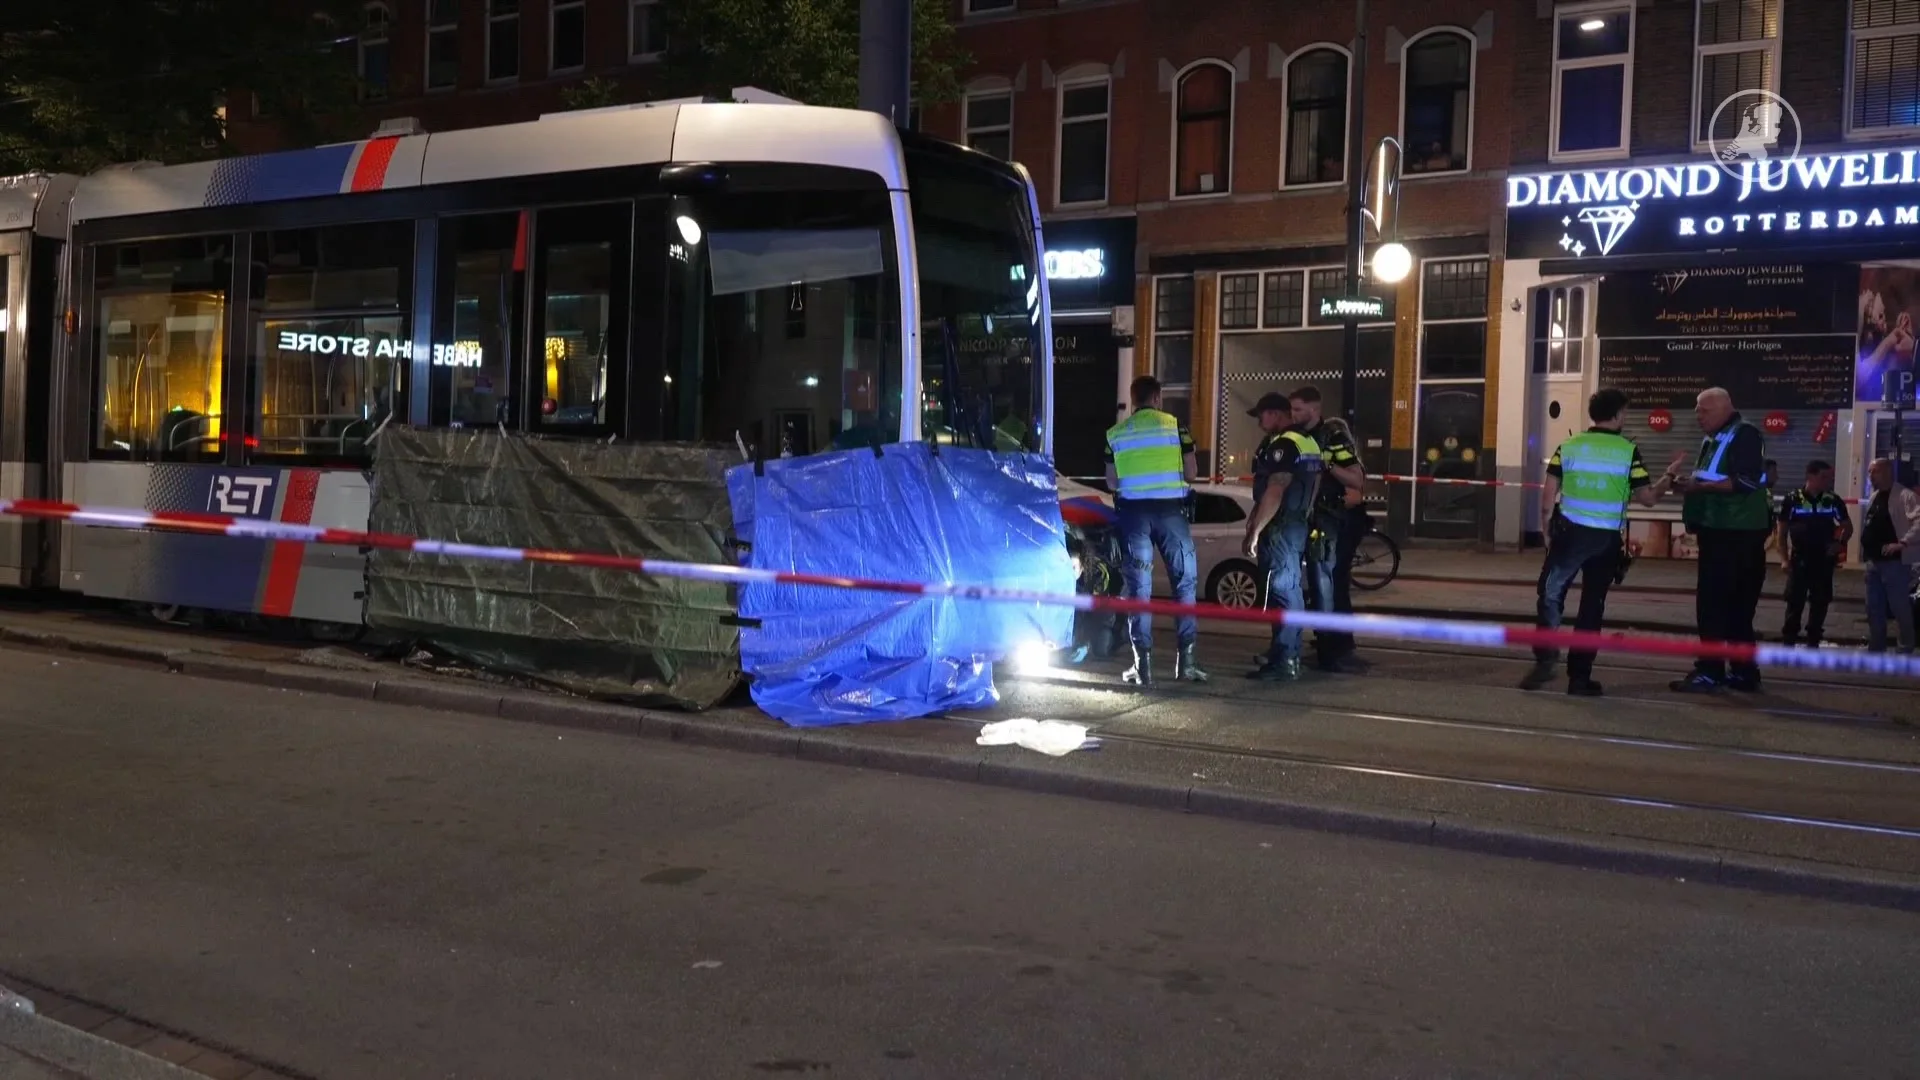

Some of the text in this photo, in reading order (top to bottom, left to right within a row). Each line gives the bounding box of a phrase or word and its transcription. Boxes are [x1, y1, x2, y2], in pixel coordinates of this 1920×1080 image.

[1507, 150, 1920, 207] DIAMOND JUWELI
[1679, 206, 1919, 236] ROTTERDAM
[1044, 248, 1105, 279] OBS
[1690, 264, 1804, 277] DIAMOND JUWELIER
[1747, 277, 1804, 285] ROTTERDAM
[959, 337, 1007, 352] NKOOP
[1667, 341, 1693, 351] Goud
[1701, 341, 1730, 350] Zilver
[1738, 340, 1782, 351] Horloges
[1059, 355, 1096, 365] WATCH
[1900, 371, 1913, 390] P
[1650, 416, 1670, 425] 20%
[1766, 418, 1787, 427] 50%
[1815, 412, 1834, 443] SALE
[208, 475, 273, 515] RET
